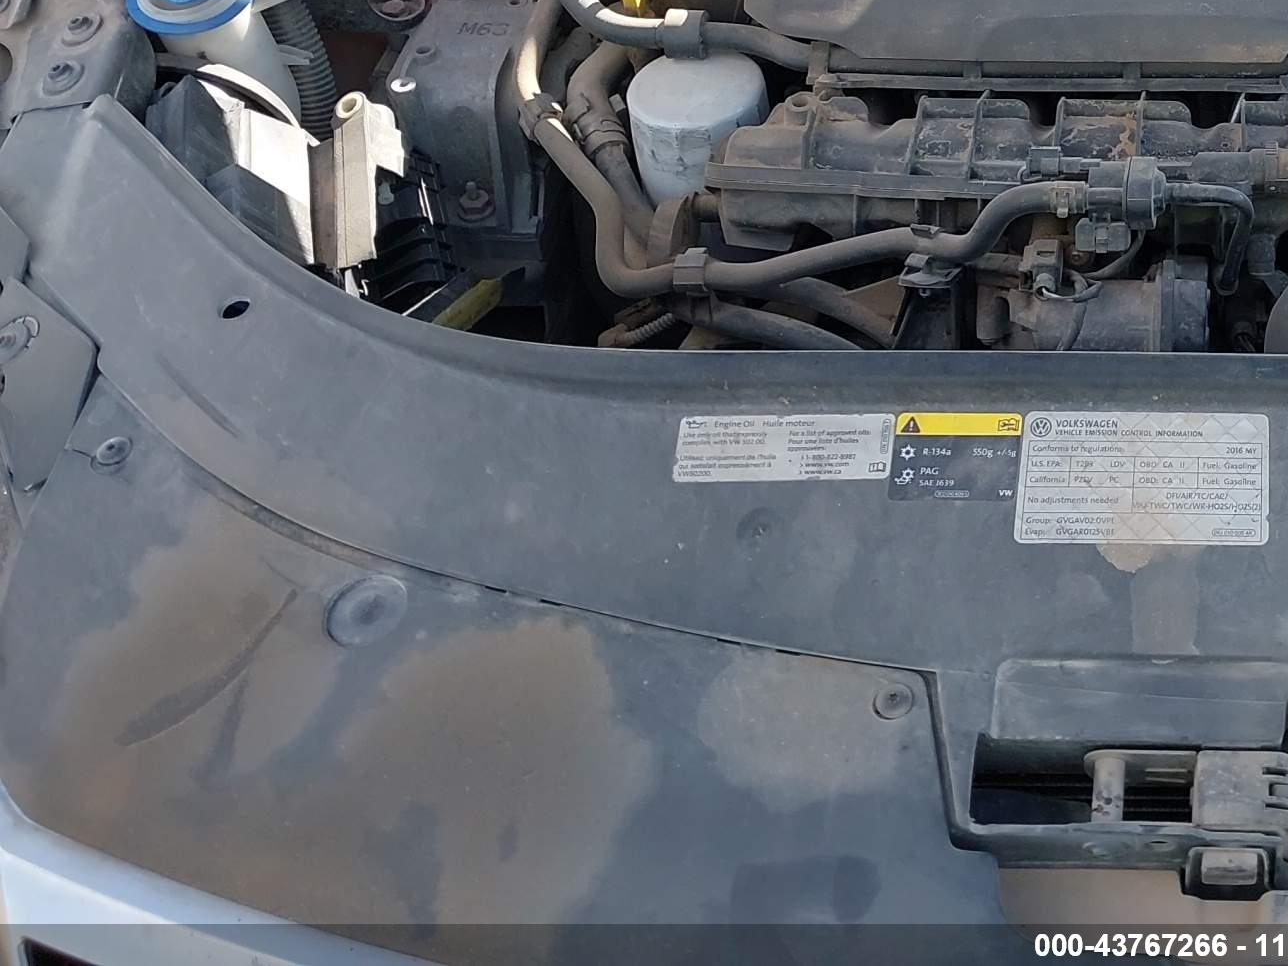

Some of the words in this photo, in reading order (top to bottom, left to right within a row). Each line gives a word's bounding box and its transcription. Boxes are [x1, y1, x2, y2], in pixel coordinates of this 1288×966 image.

[714, 420, 742, 430] Engine
[743, 420, 755, 428] Oil
[762, 420, 784, 428] Huile
[785, 420, 816, 428] moteur
[1055, 419, 1119, 428] VOLKSWAGEN
[1121, 429, 1153, 437] CONTROL
[922, 447, 952, 456] R-134a
[972, 448, 994, 458] 550g
[1226, 446, 1243, 454] 2016
[1223, 462, 1257, 470] Gasoline
[920, 467, 939, 475] PAG
[1223, 478, 1257, 486] Gasoline
[998, 489, 1014, 497] VW
[1040, 496, 1088, 505] adjustments
